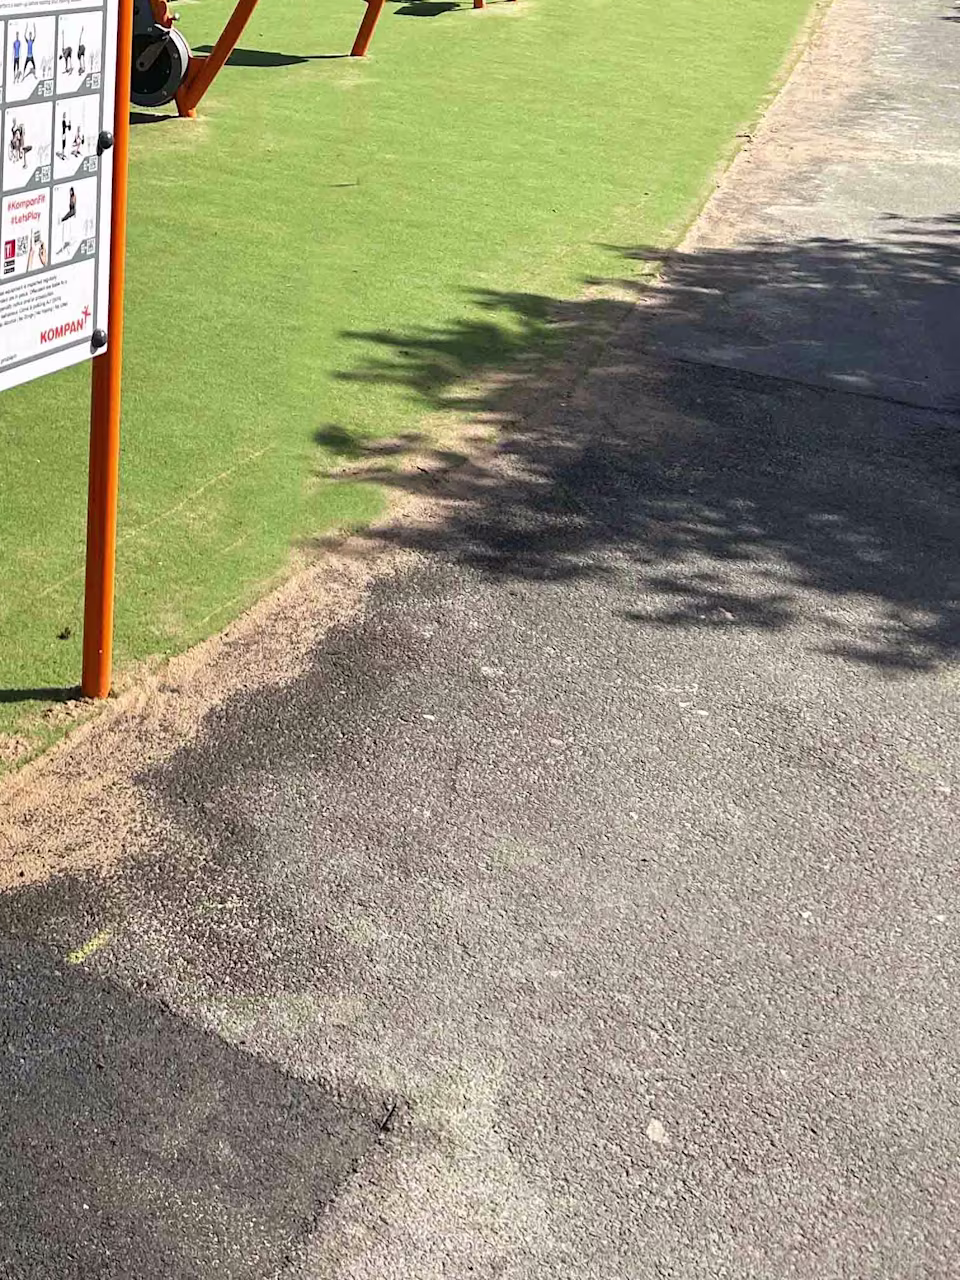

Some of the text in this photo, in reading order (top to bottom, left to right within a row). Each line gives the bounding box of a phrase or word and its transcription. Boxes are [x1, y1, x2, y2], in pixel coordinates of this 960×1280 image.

[7, 194, 46, 212] #KompanFit
[10, 211, 41, 226] #LetsPlay
[40, 318, 83, 344] KOMPAN
